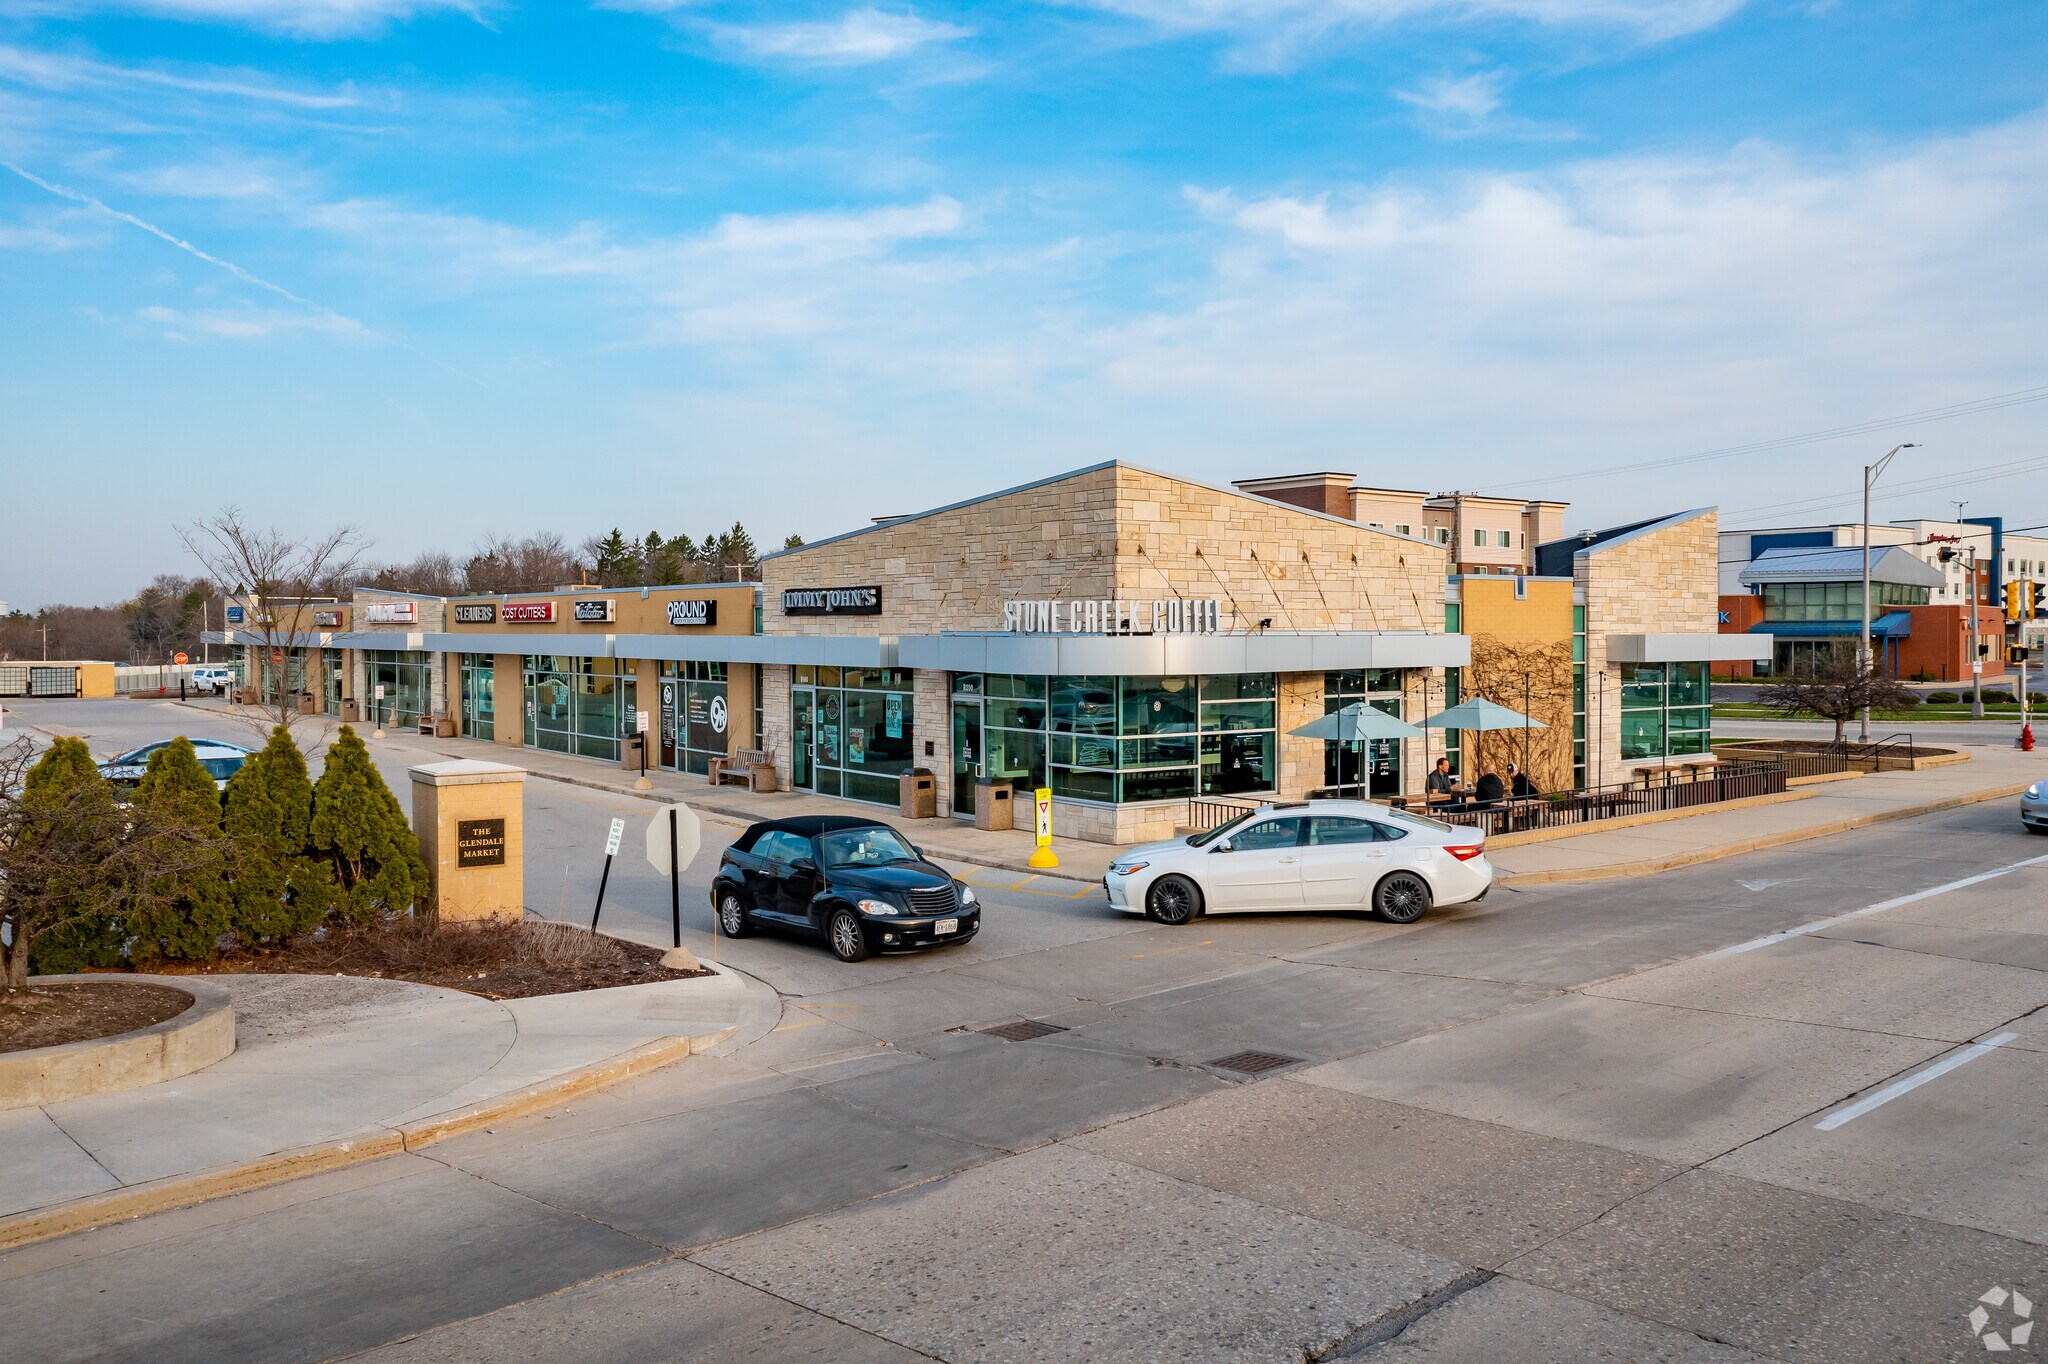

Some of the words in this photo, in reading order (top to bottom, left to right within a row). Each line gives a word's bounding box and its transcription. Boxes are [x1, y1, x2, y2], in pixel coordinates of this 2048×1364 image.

[781, 591, 824, 612] JIMMY
[826, 588, 876, 611] JOHN'S
[455, 606, 492, 621] CLEANERS
[501, 608, 518, 619] COST
[518, 606, 546, 619] CUTTERS
[667, 601, 706, 623] 9ROUND
[1004, 600, 1062, 632] STONE
[1070, 600, 1142, 632] CREEK
[1152, 600, 1222, 632] COFFEE
[887, 699, 902, 711] OPEN
[473, 828, 491, 836] THE
[459, 838, 504, 848] GLENDALE
[464, 849, 500, 858] MARKET
